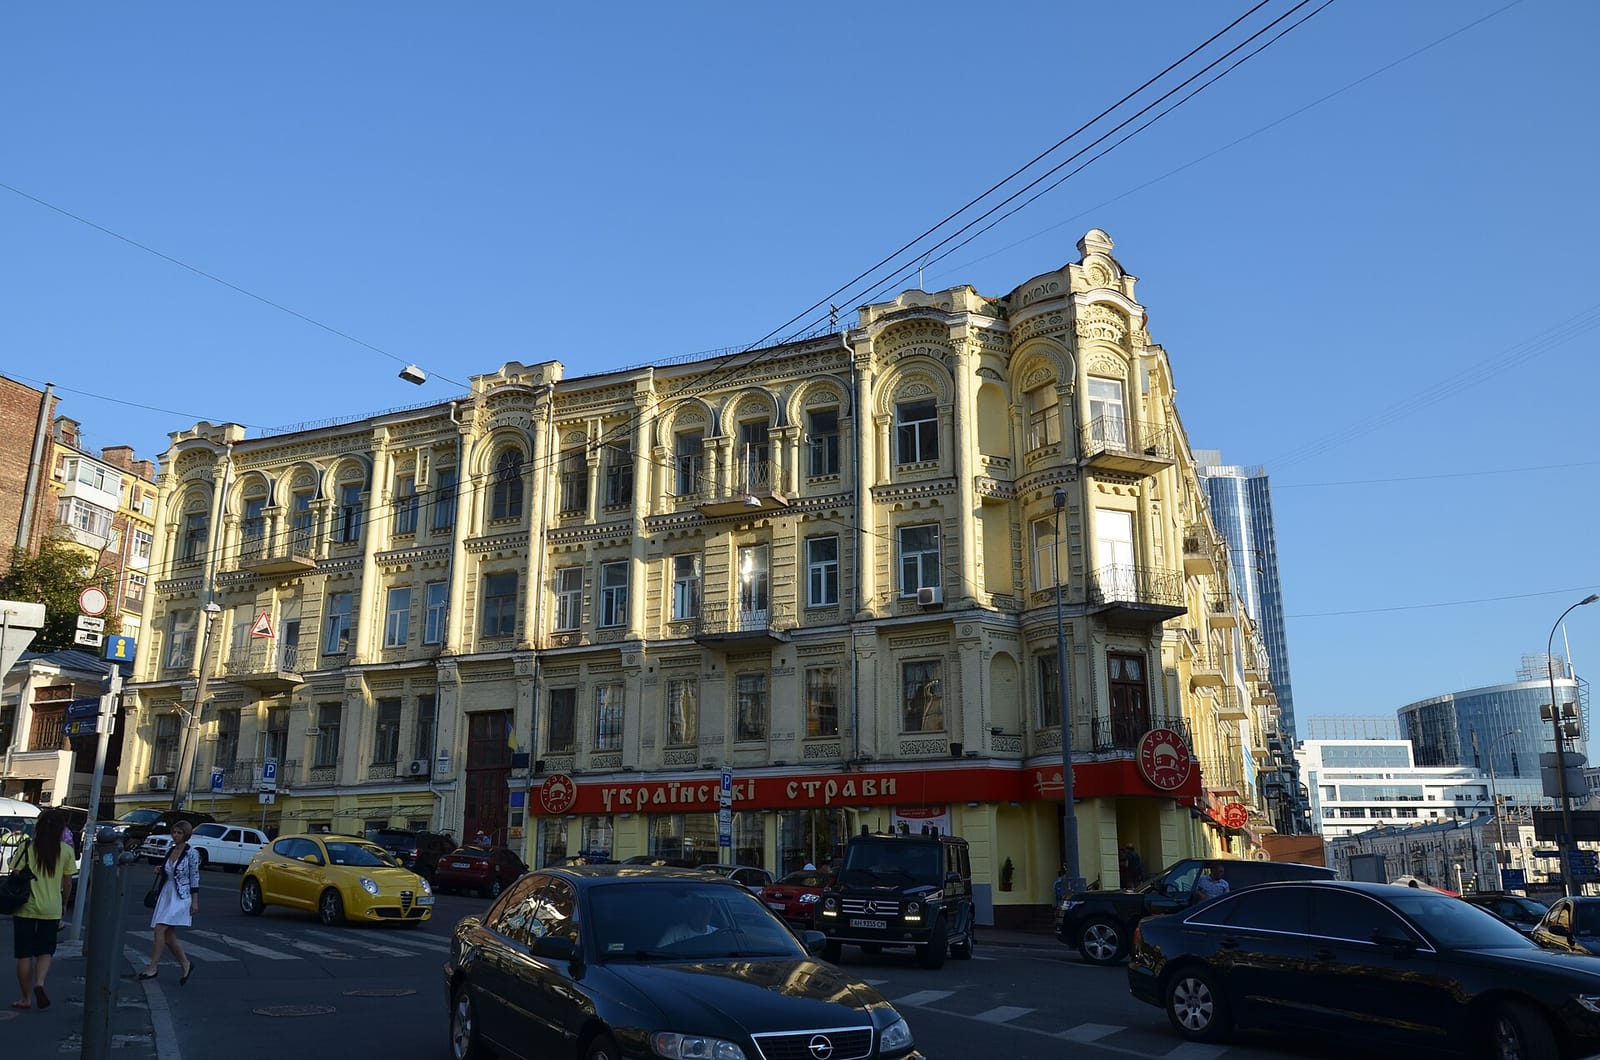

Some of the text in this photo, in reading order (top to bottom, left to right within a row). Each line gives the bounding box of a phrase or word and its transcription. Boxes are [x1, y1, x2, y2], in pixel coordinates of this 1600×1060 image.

[1143, 731, 1188, 762] ПУЗАТА
[266, 764, 275, 777] P
[1151, 770, 1184, 786] ХАТА
[724, 775, 731, 790] P
[786, 777, 897, 804] страви
